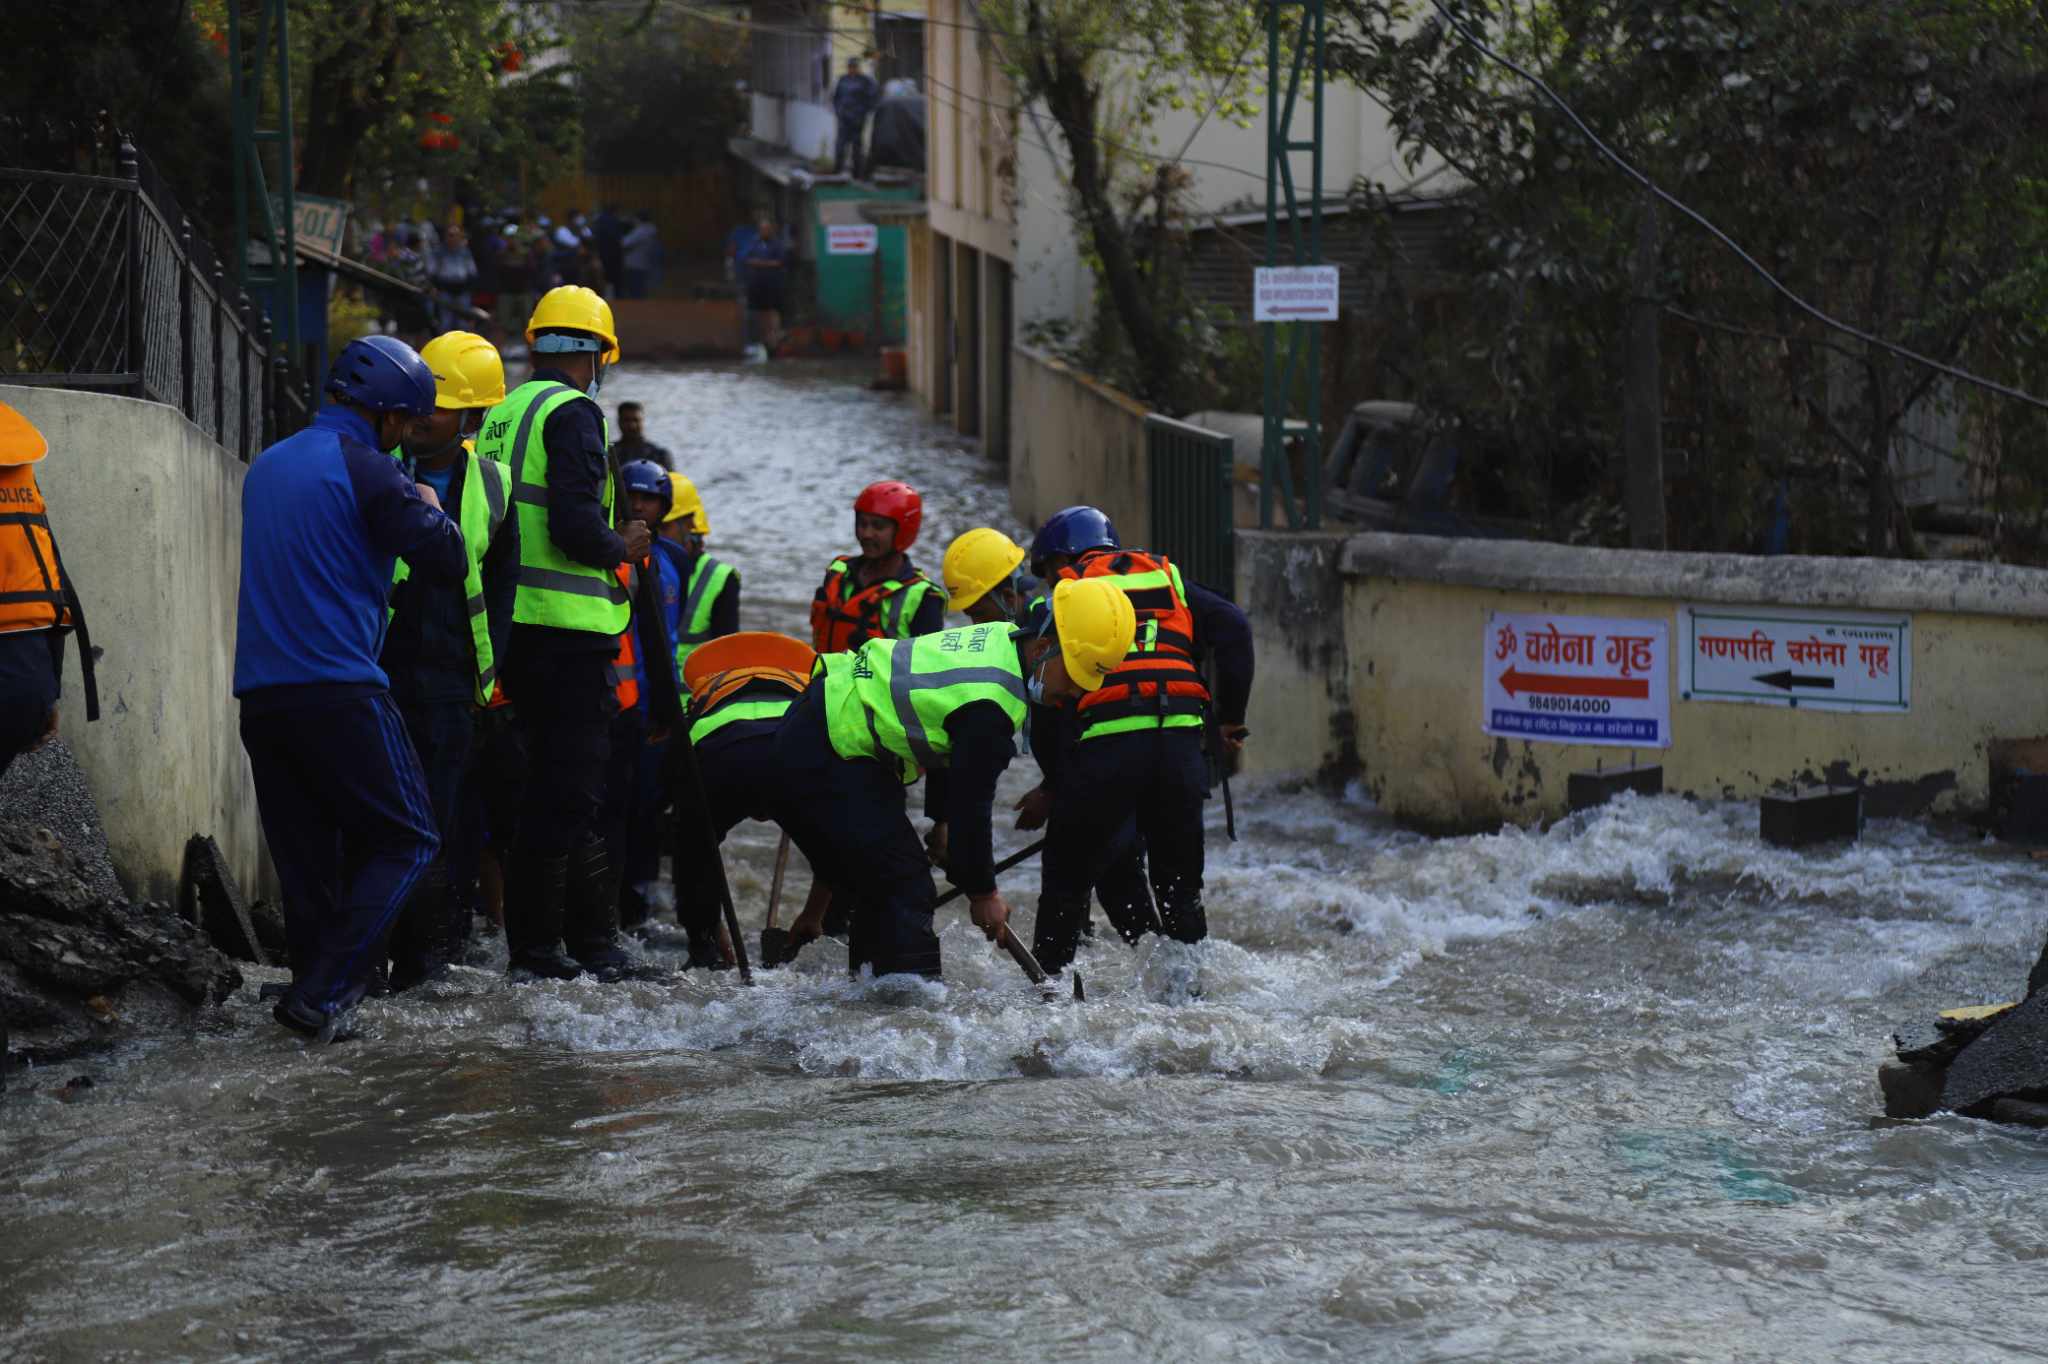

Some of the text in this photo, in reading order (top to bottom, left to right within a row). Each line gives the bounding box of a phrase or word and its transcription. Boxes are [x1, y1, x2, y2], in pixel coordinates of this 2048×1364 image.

[1525, 623, 1596, 666] चमेना
[1606, 635, 1655, 678] गृह
[1698, 628, 1890, 678] गणपति चमेना गृह
[1529, 695, 1611, 713] 9849014000
